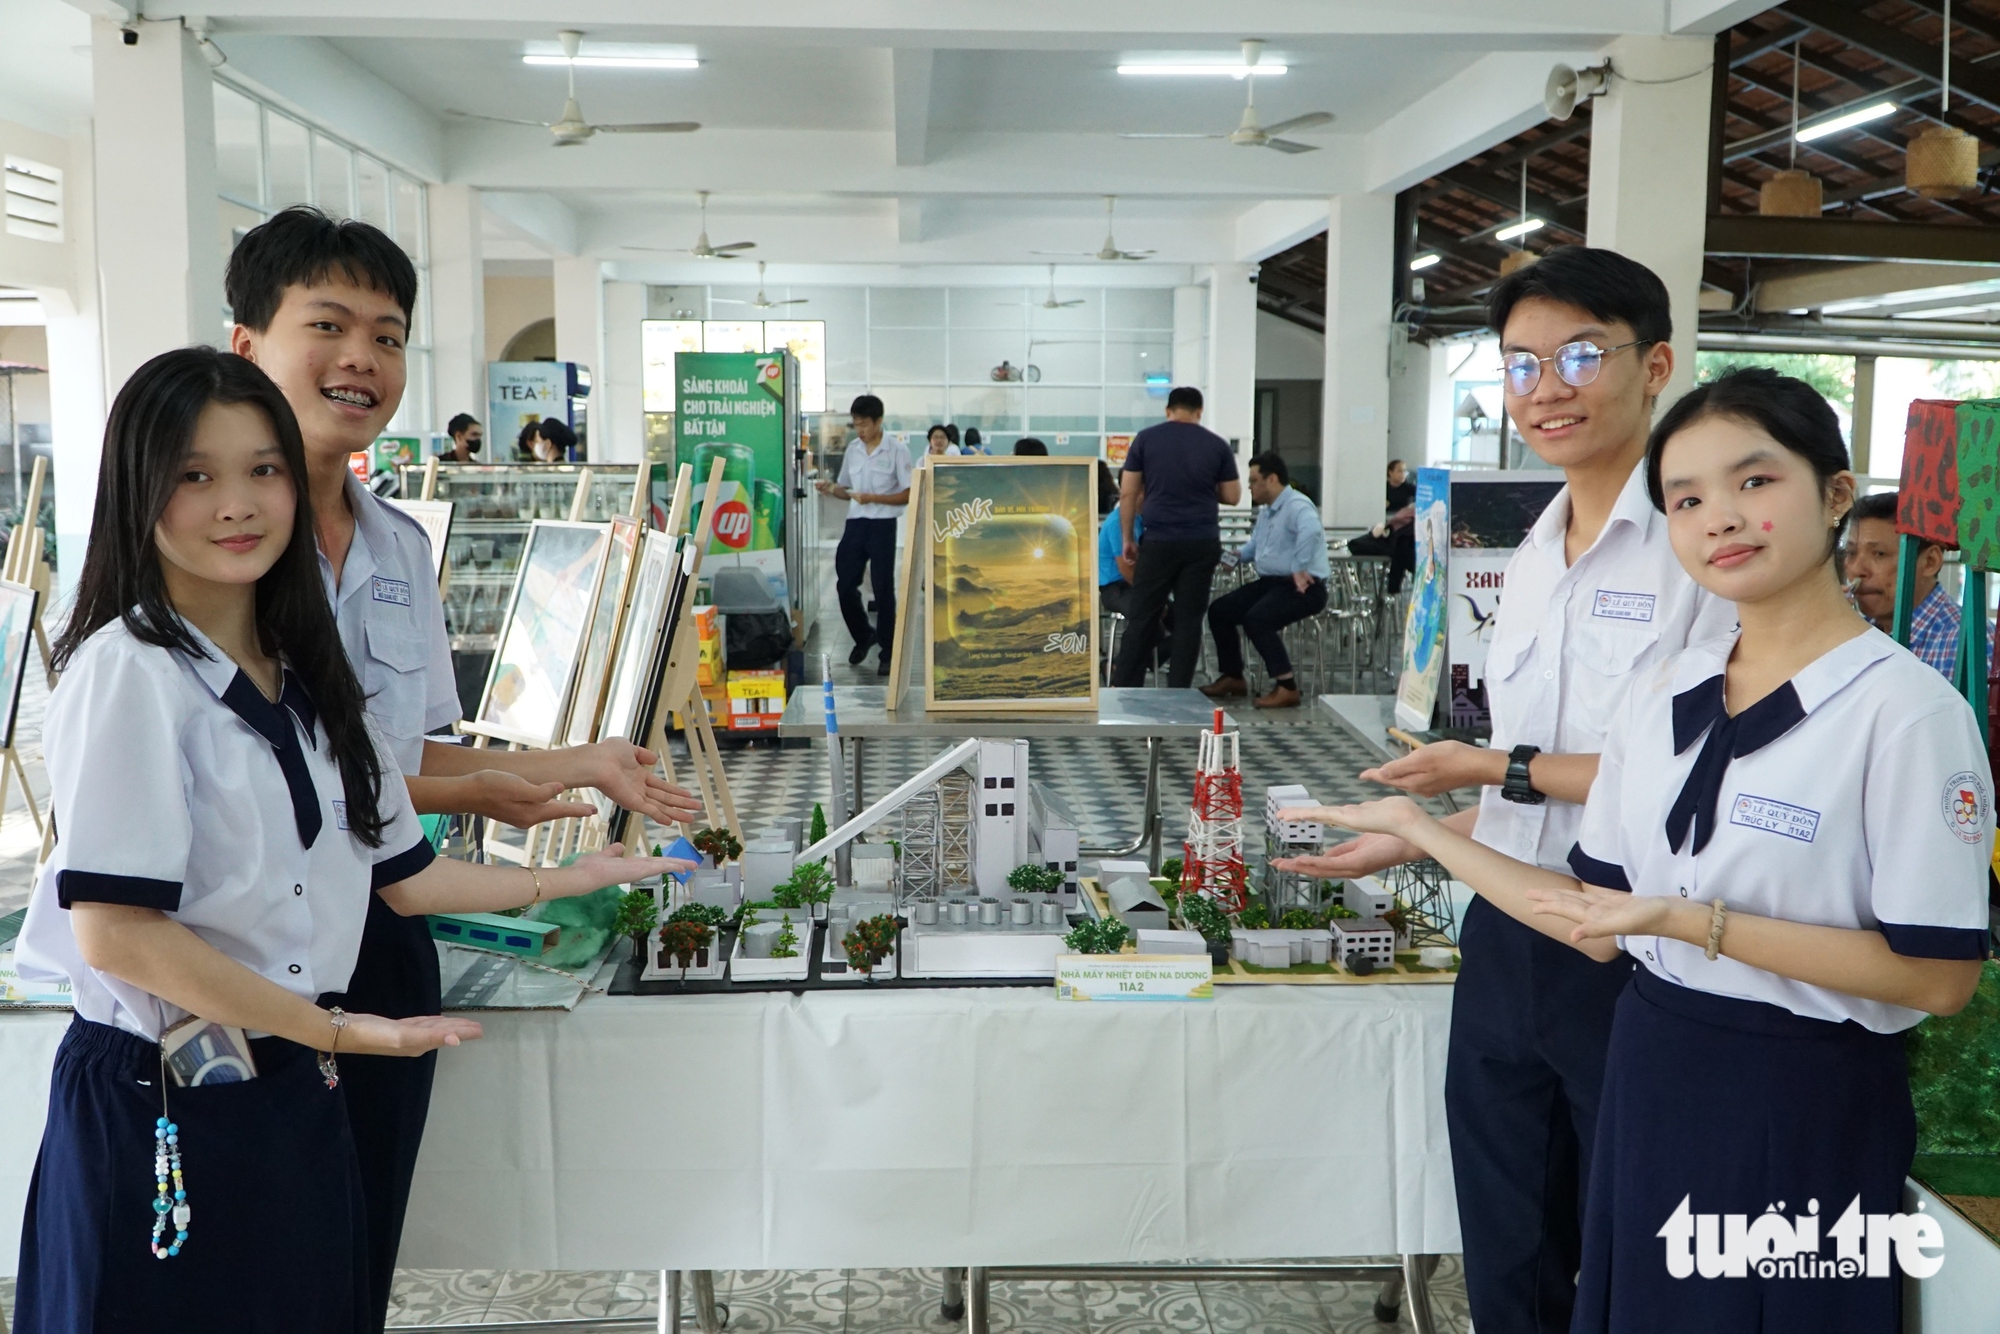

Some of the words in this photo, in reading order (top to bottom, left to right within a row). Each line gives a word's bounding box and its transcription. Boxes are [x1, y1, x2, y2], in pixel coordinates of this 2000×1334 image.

[682, 376, 713, 394] SẢNG
[714, 378, 748, 394] KHOÁI
[683, 400, 706, 415] CHO
[707, 396, 733, 415] TRẢI
[734, 399, 776, 418] NGHIỆM
[683, 418, 706, 436] BẤT
[706, 418, 726, 438] TẬN
[1623, 599, 1636, 607] QUÝ
[1740, 814, 1763, 826] TRÚC
[1765, 820, 1778, 829] LY
[1753, 805, 1765, 814] LÊ
[1767, 808, 1790, 820] QUÝ
[1792, 815, 1815, 827] ĐÔN
[1790, 826, 1810, 838] 11A2
[1061, 969, 1081, 979] NHÀ
[1083, 969, 1103, 979] MÁY
[1106, 970, 1132, 980] NHIỆT
[1135, 970, 1157, 980] ĐIỆN
[1119, 982, 1144, 992] 11A2
